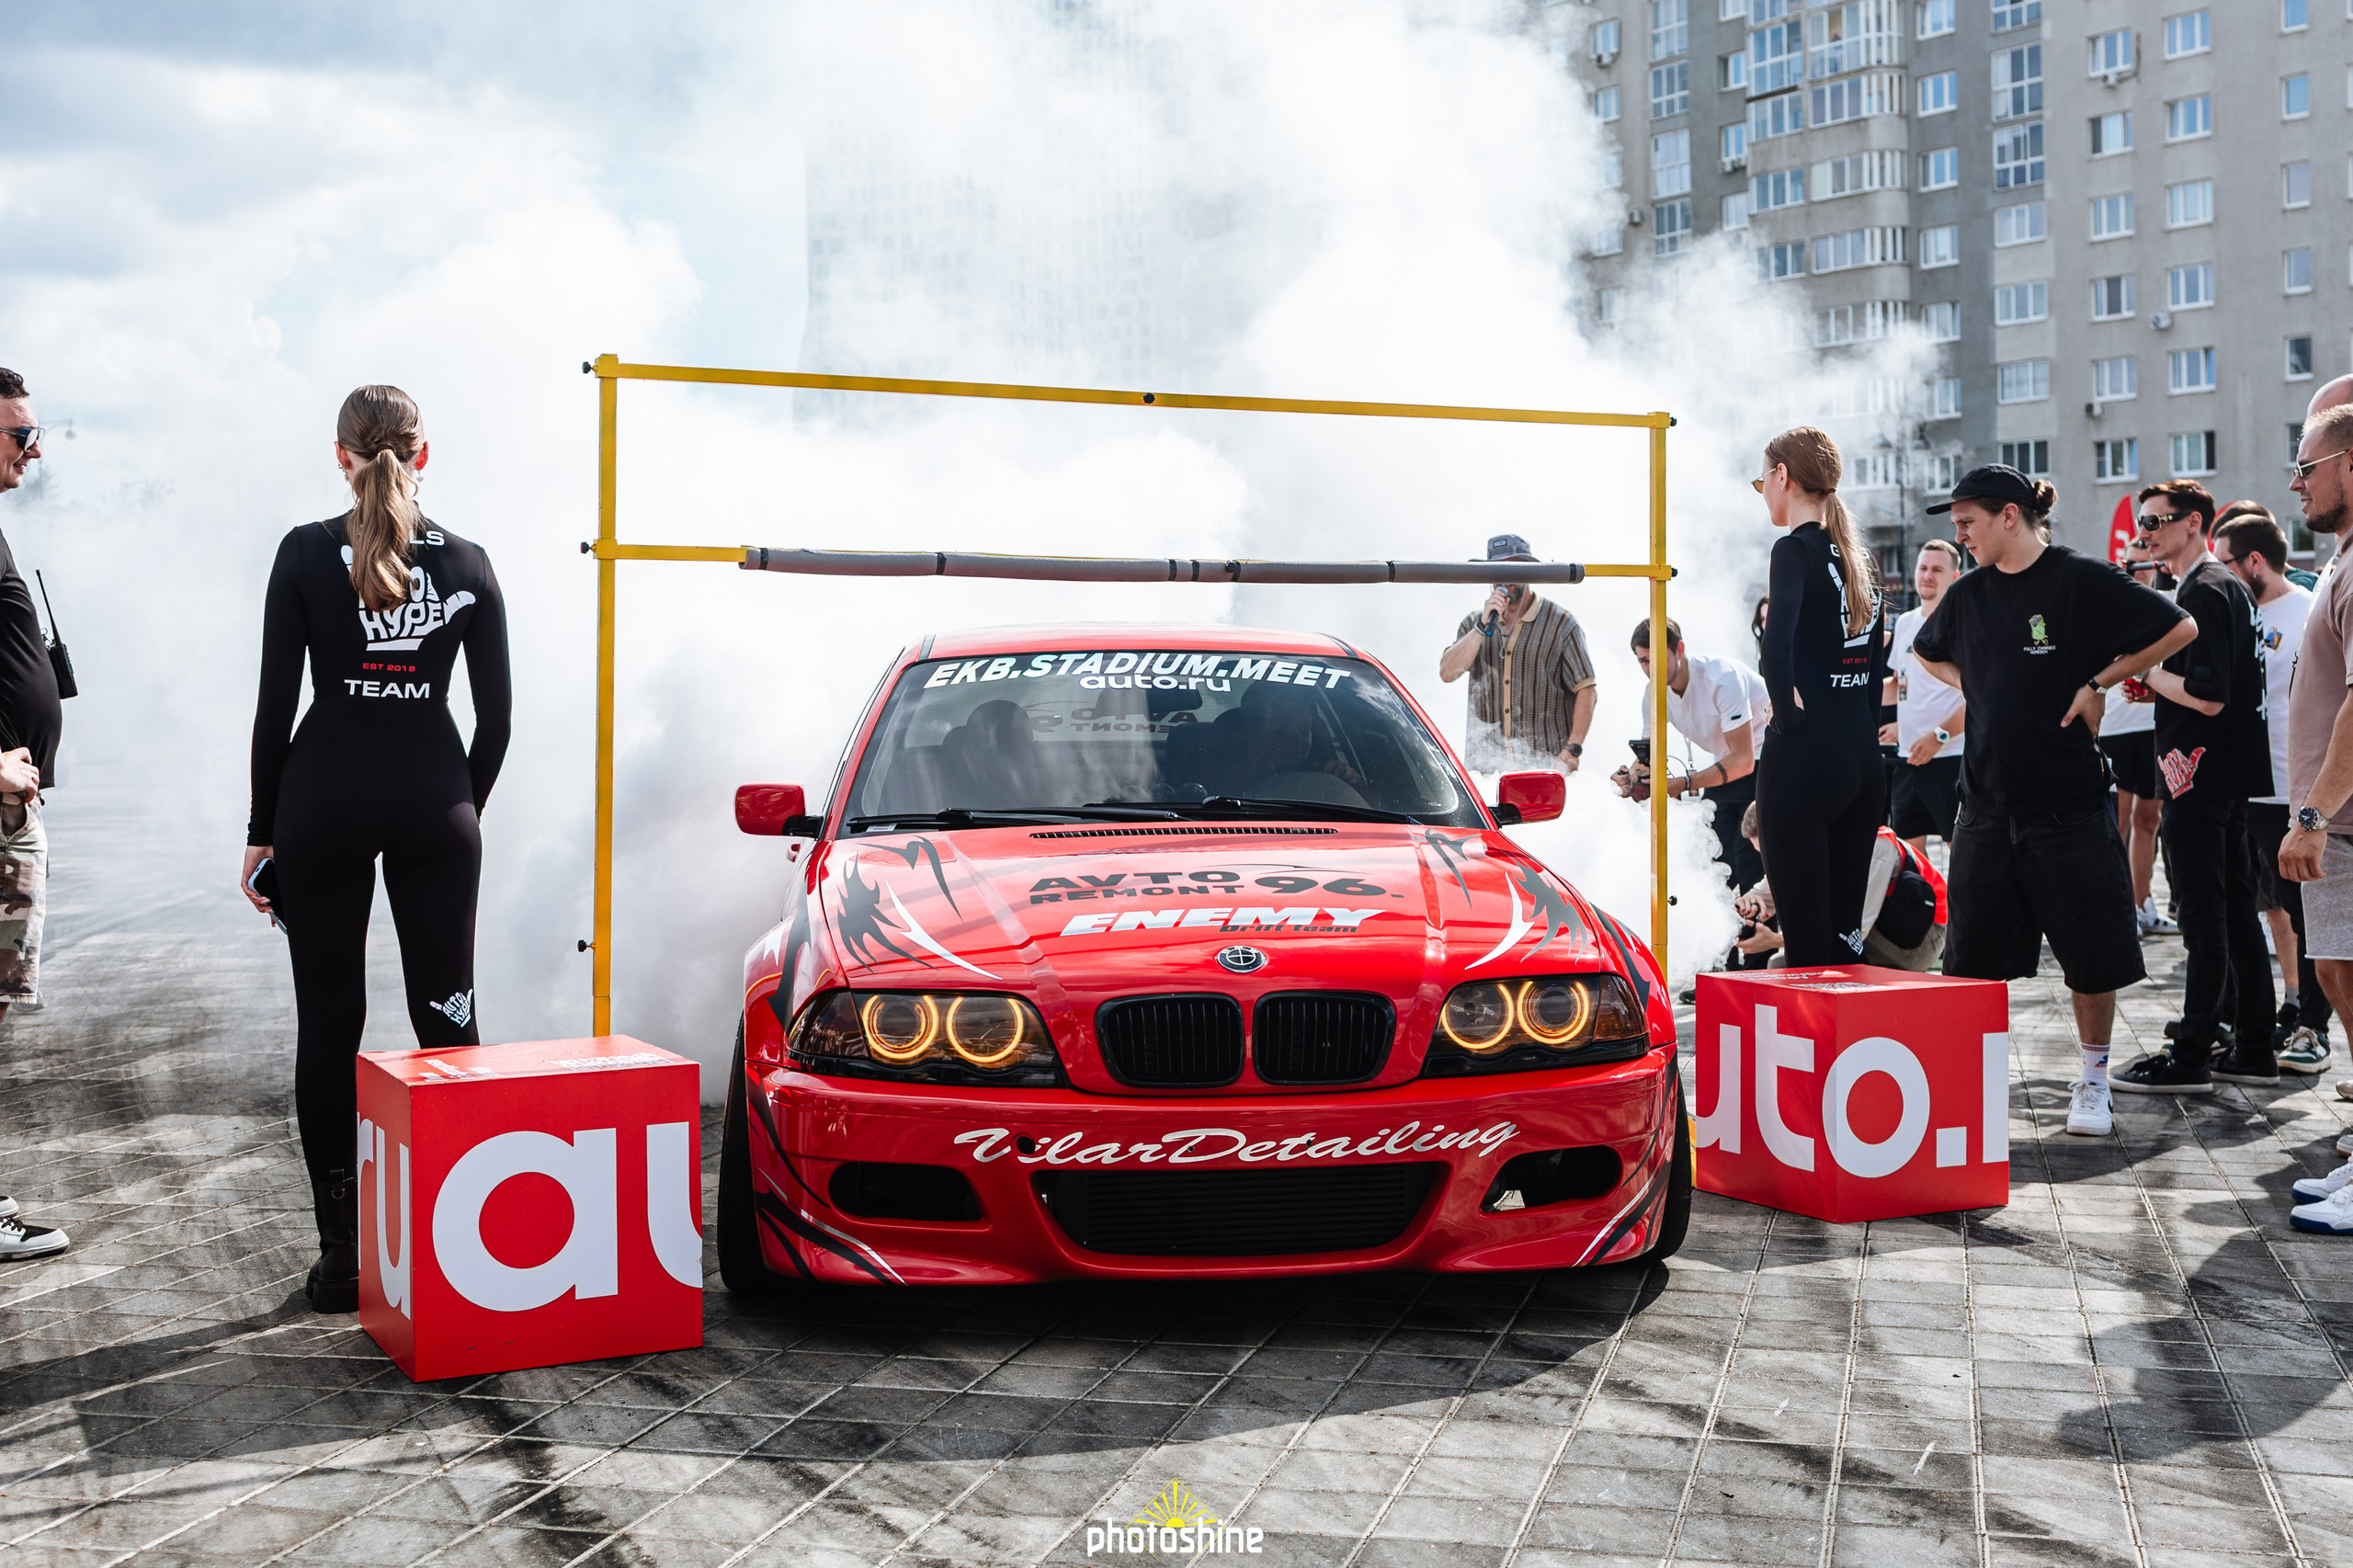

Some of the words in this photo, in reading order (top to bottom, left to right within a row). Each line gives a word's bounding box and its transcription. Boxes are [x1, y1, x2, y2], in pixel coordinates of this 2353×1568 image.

[358, 601, 444, 641] HYPE
[362, 662, 384, 671] EST
[386, 664, 416, 673] 2018
[923, 652, 1351, 690] EKB.STADIUM.MEET
[344, 678, 431, 699] TEAM
[1079, 673, 1232, 693] auto.ru
[1029, 870, 1241, 892] AVTO
[1029, 885, 1245, 904] REMONT
[1059, 906, 1388, 937] ENEMY
[1218, 925, 1284, 933] Drift
[1292, 925, 1358, 933] team
[442, 992, 465, 1017] AUTO
[449, 1000, 472, 1025] HYPE
[953, 1119, 1521, 1165] VilarDetailing
